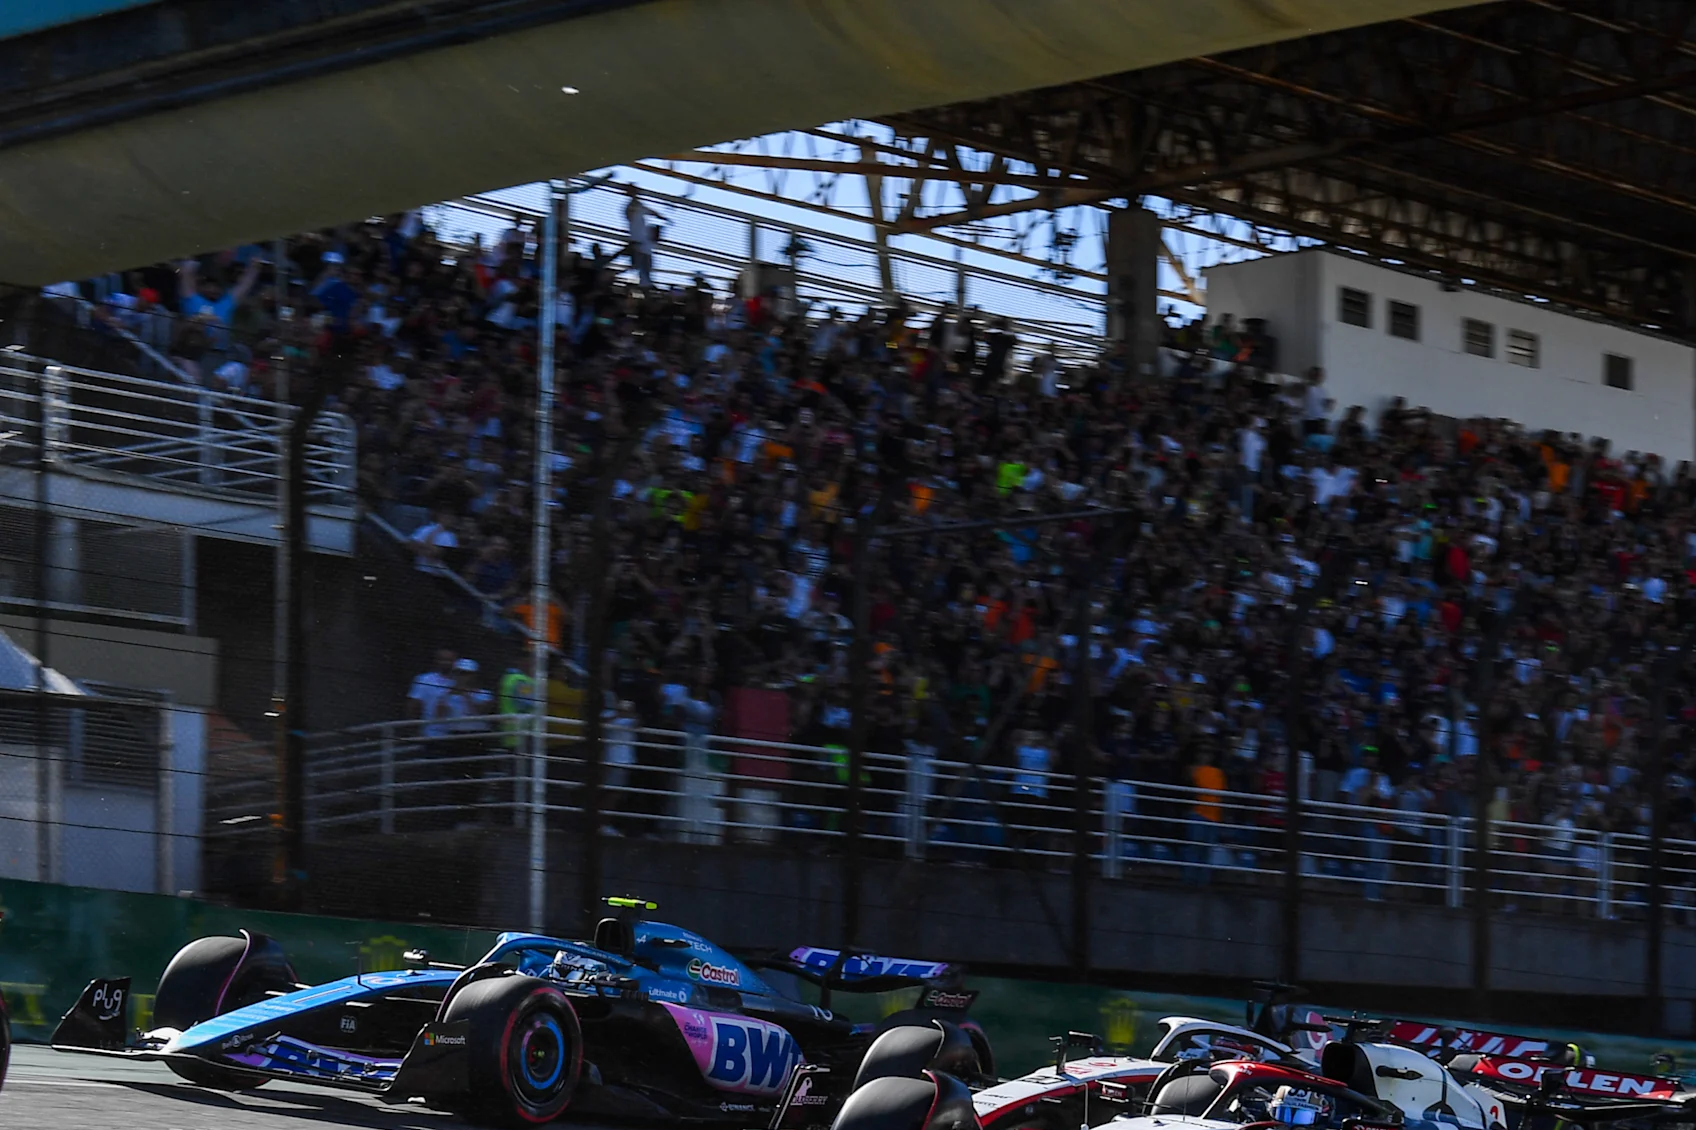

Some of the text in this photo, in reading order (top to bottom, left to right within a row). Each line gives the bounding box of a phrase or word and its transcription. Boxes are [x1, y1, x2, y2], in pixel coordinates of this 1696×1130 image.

[699, 962, 740, 986] Castrol
[92, 983, 123, 1014] plug
[648, 987, 678, 1000] ultimate
[341, 1017, 356, 1030] FIA
[435, 1033, 467, 1046] Microsoft
[708, 1021, 803, 1090] BWT
